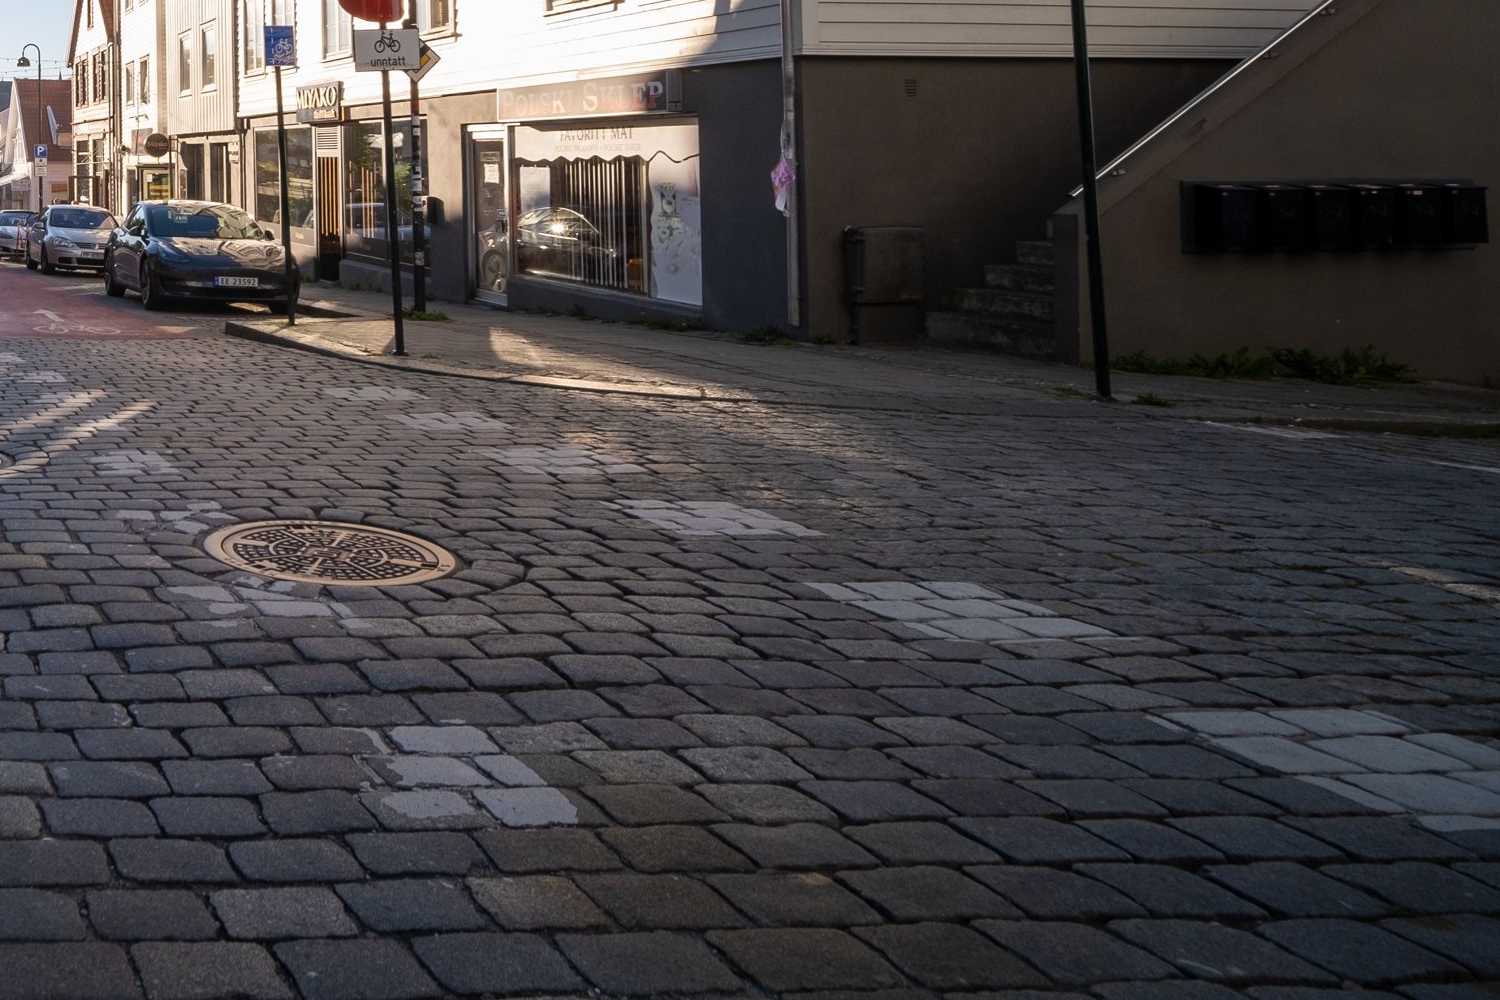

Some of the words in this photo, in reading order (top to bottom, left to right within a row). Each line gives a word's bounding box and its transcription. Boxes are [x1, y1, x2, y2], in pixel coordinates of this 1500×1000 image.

[370, 56, 406, 67] unntatt
[297, 86, 336, 109] MIYAKO
[499, 90, 572, 117] POLSKI
[582, 81, 664, 111] SKLEP
[37, 146, 44, 156] P
